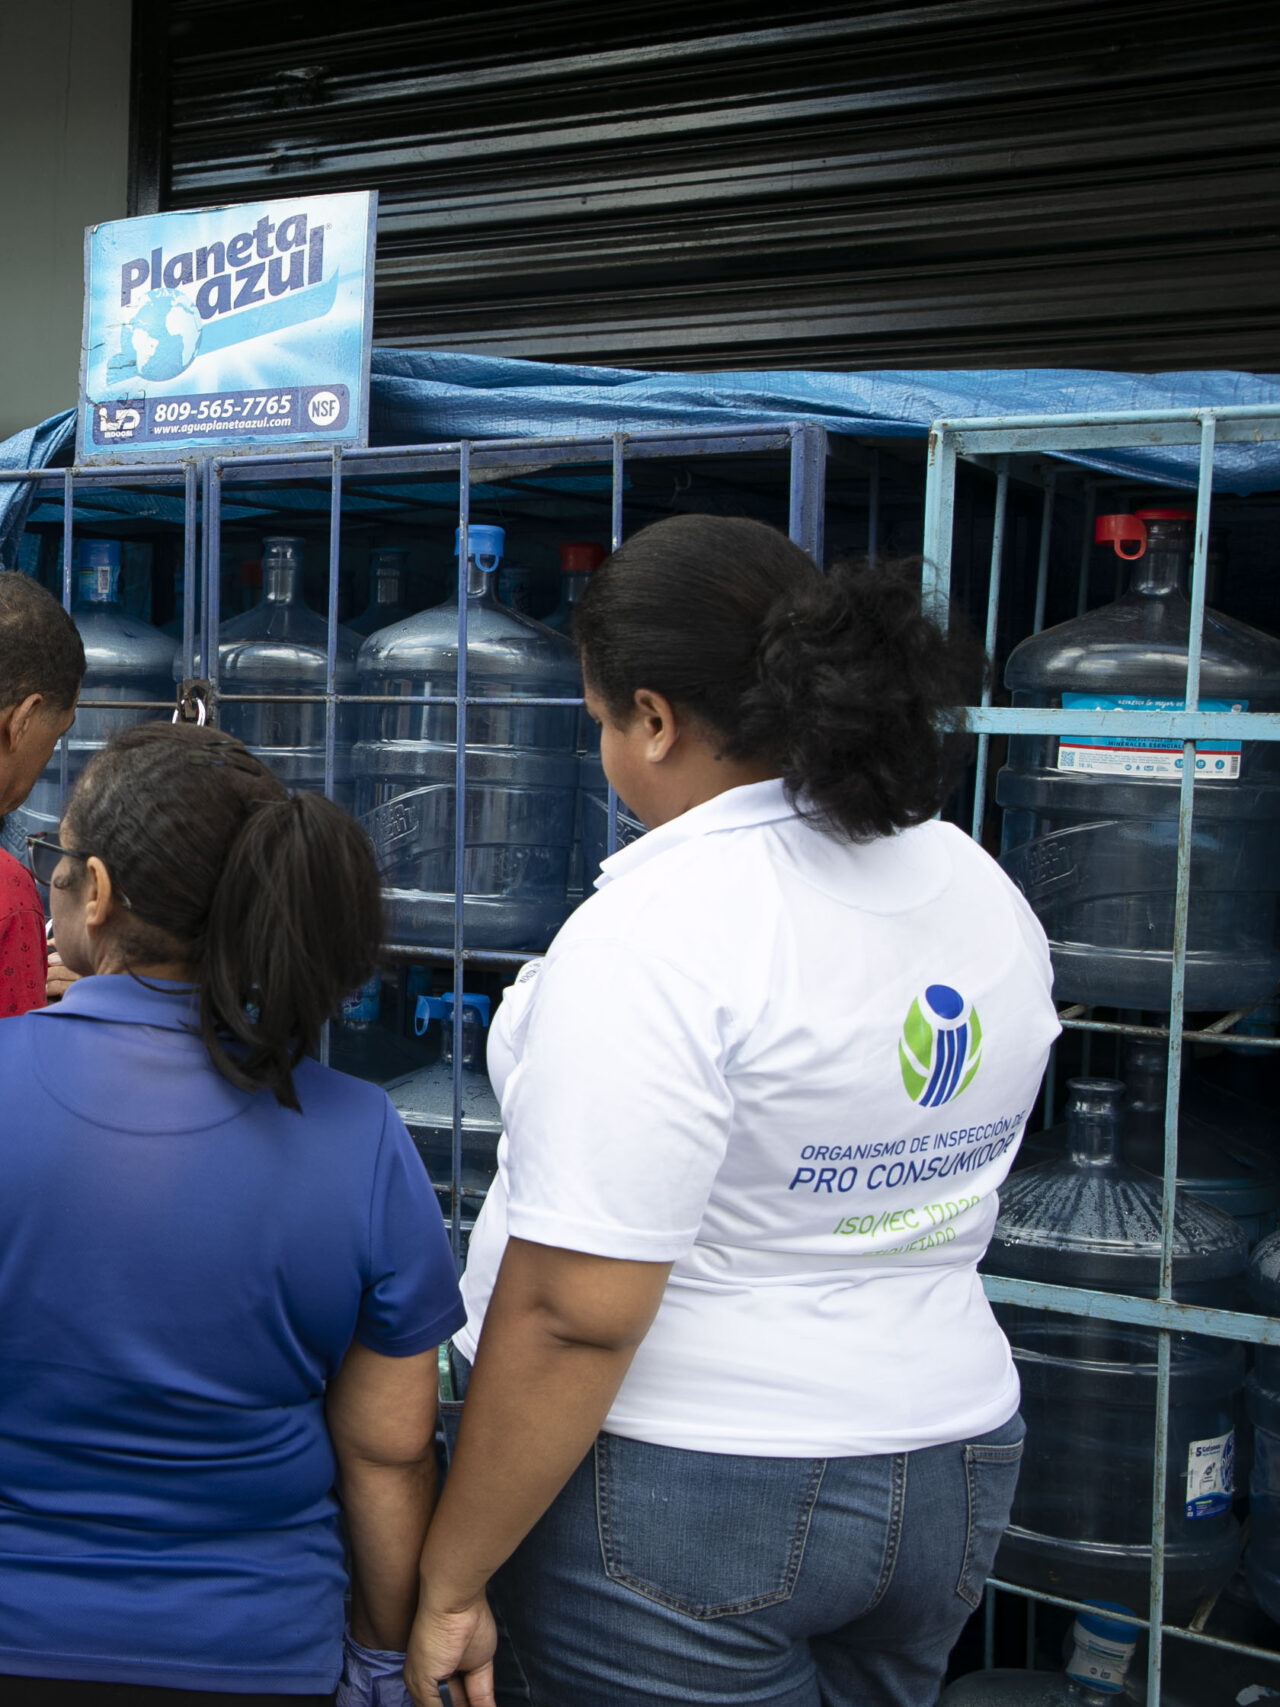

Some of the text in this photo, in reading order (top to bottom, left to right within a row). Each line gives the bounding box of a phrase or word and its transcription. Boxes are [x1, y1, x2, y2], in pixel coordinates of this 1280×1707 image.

[196, 225, 325, 320] azul
[154, 395, 291, 422] 809-565-7765
[312, 400, 336, 418] NSF
[154, 416, 291, 435] www.aguaplanetaazul.com
[801, 1140, 906, 1161] ORGANISMO
[910, 1135, 930, 1153] DE
[933, 1116, 1012, 1150] INSPECCIÓN
[788, 1132, 1016, 1193] PRO CONSUMIDOR
[833, 1208, 919, 1237] ISO/IEC
